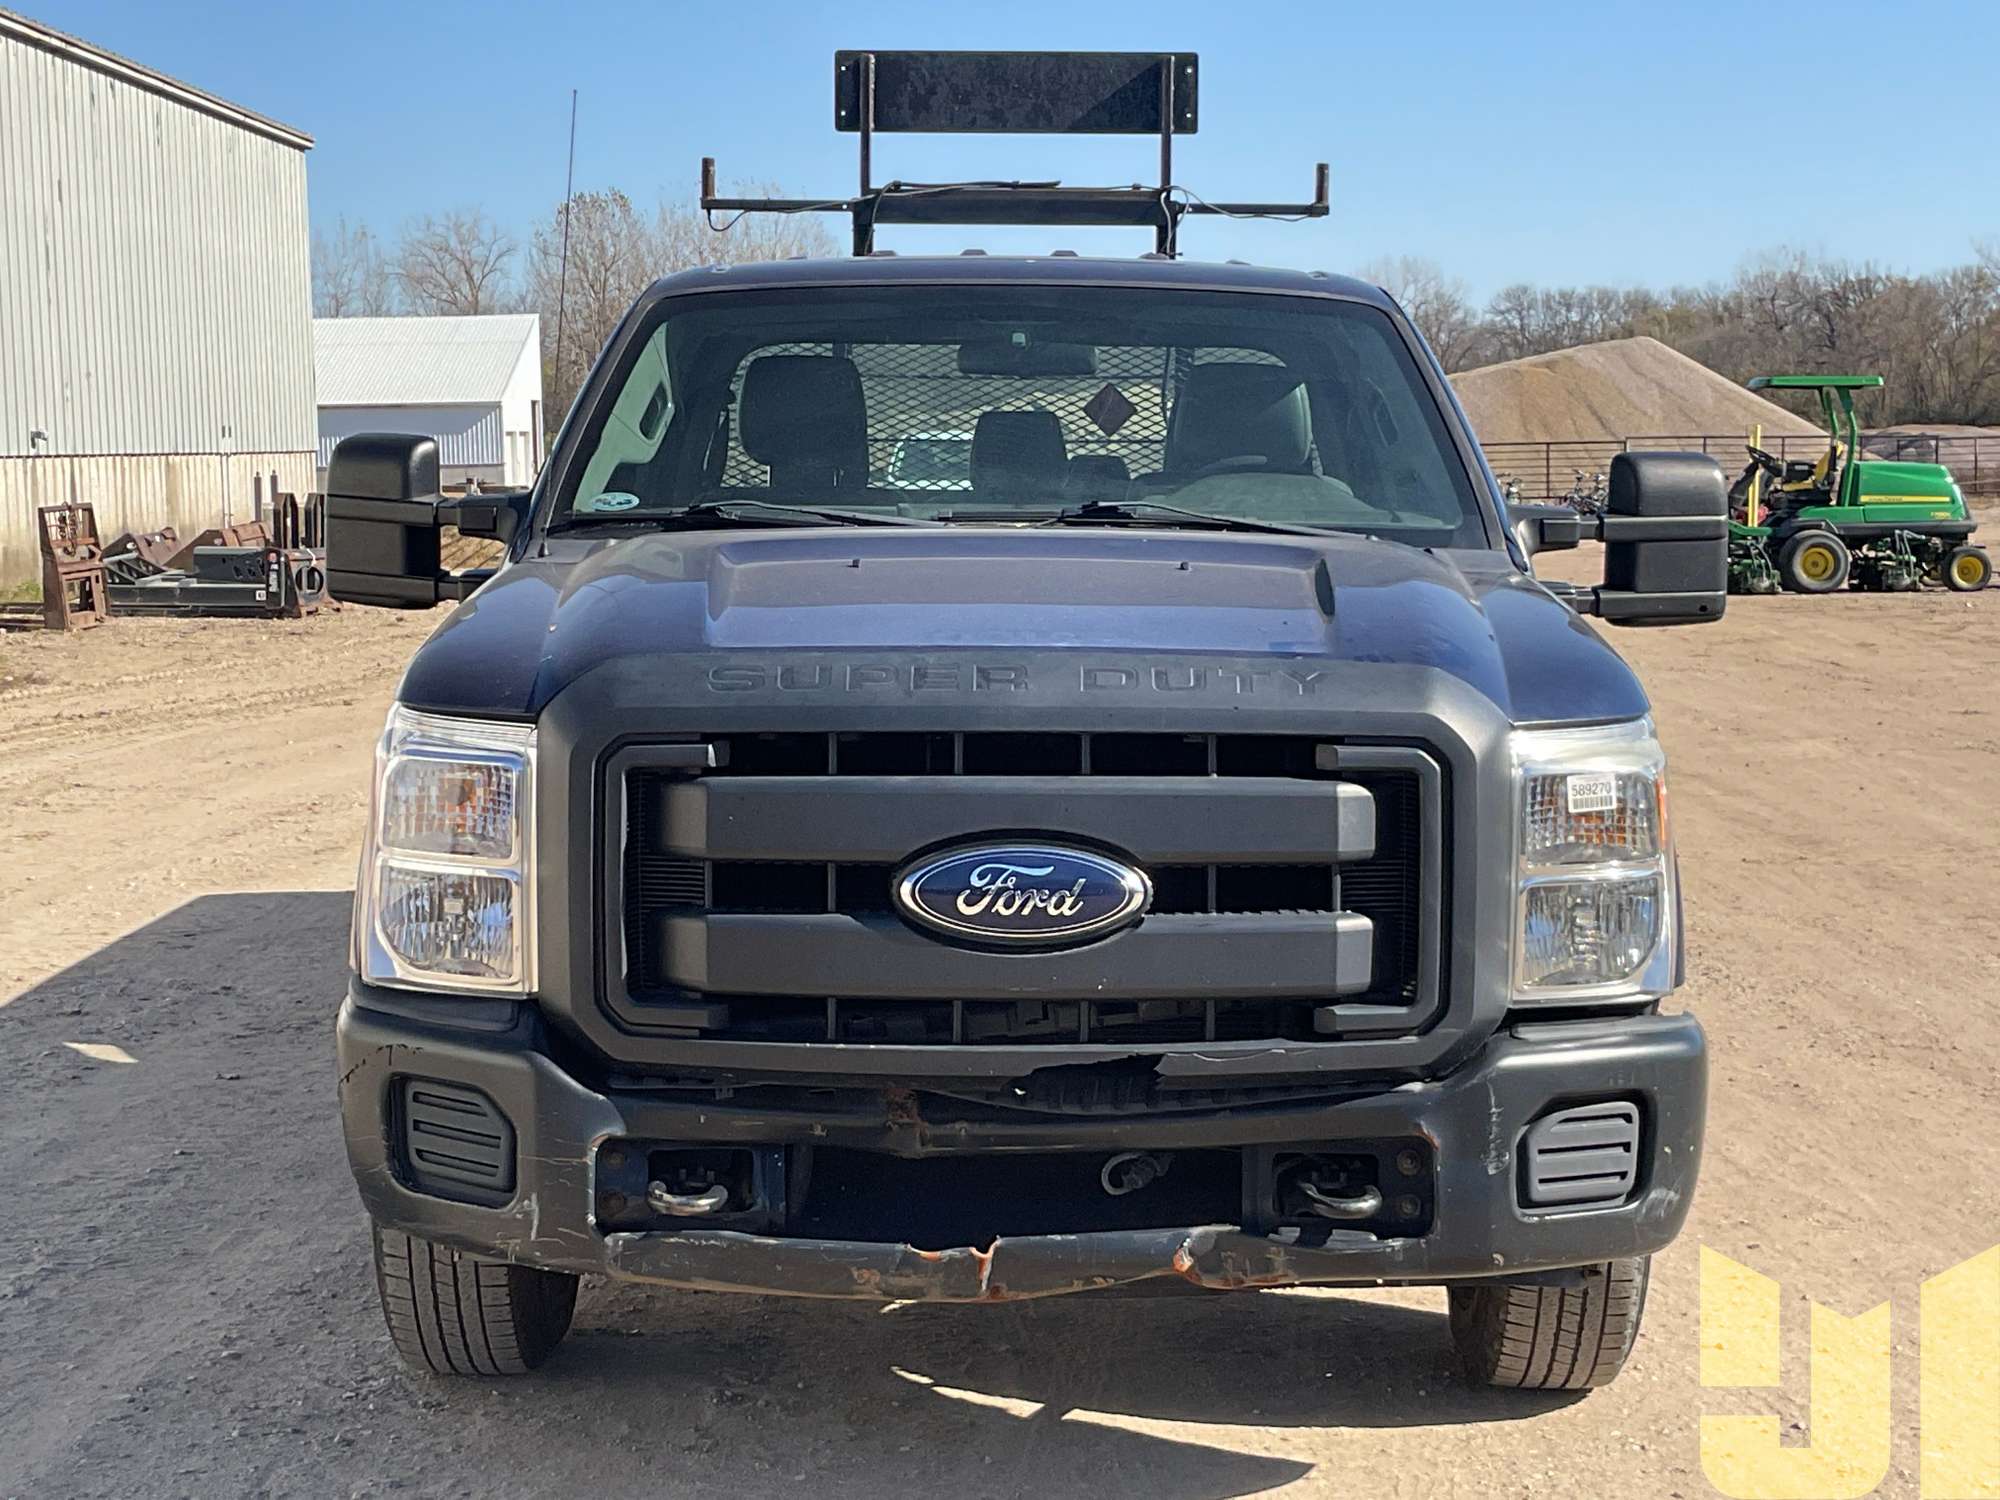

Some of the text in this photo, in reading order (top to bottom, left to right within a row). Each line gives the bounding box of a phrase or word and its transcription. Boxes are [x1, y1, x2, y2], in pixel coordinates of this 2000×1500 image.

[706, 664, 1328, 695] SUPER DUTY
[1571, 782, 1612, 797] 589270
[956, 863, 1087, 917] Ford
